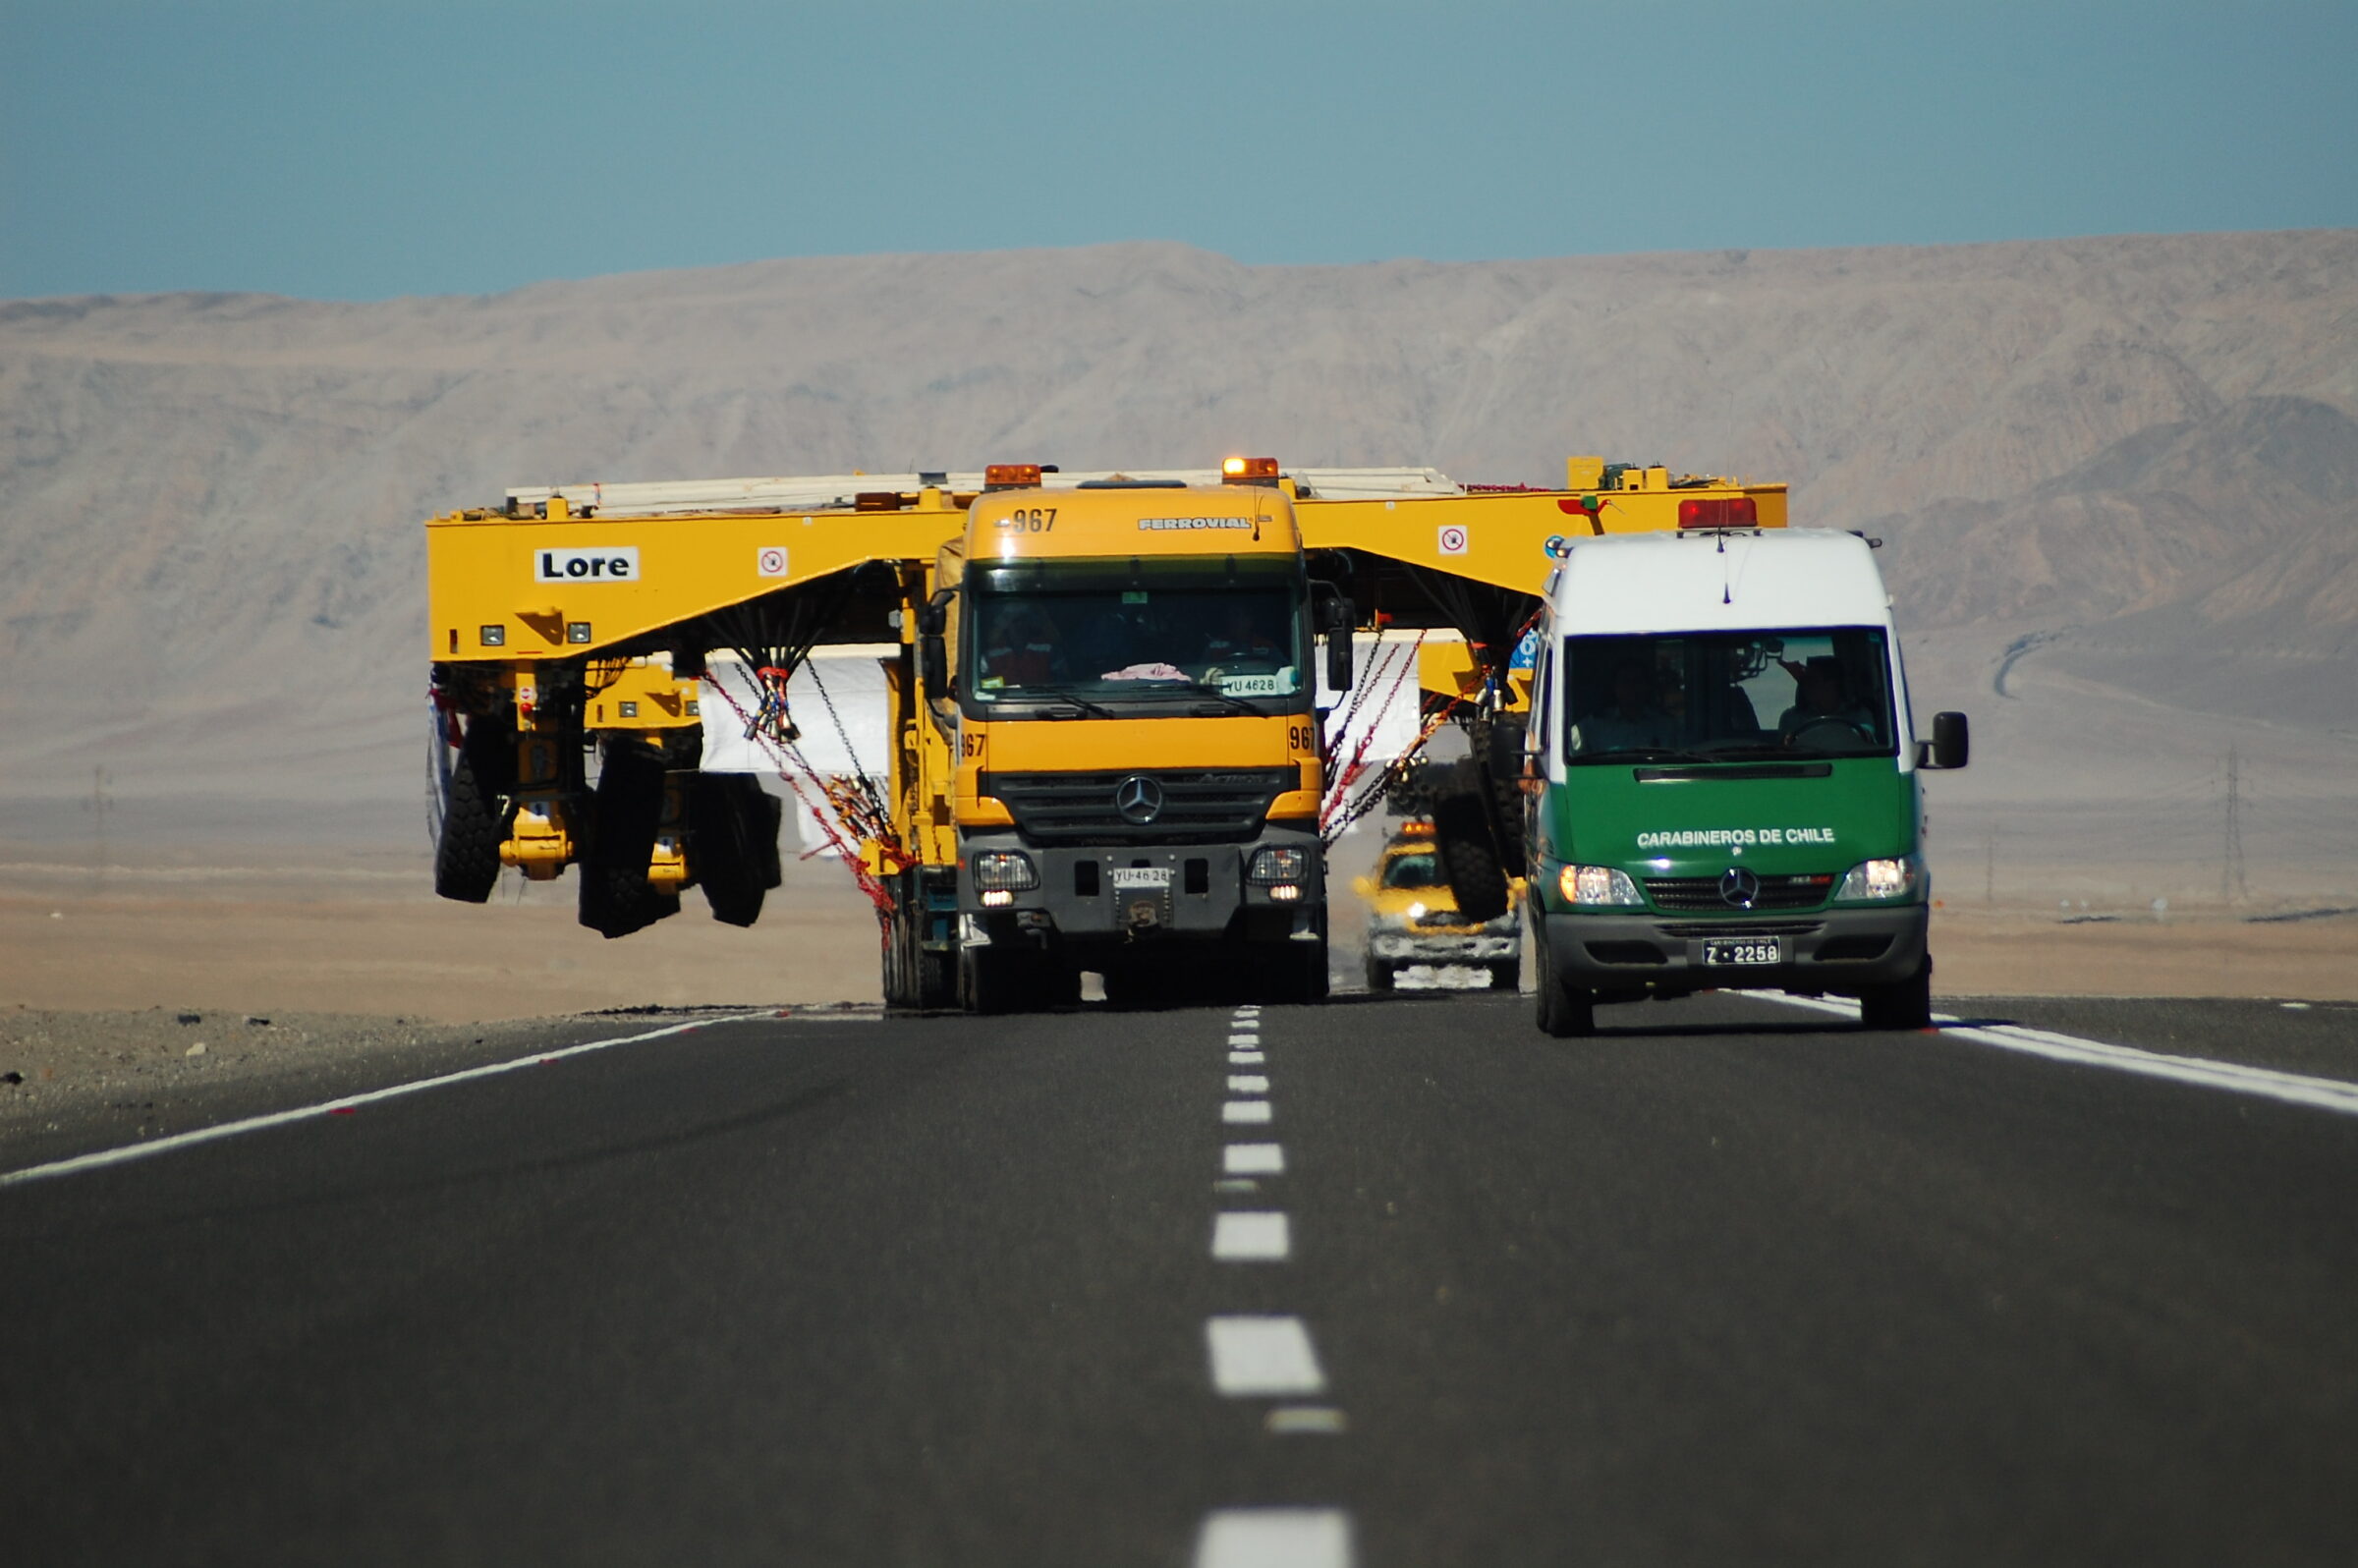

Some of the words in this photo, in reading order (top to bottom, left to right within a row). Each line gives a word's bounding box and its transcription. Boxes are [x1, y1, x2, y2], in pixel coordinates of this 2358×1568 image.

[1013, 508, 1057, 532] 967
[1138, 517, 1252, 531] FERROVIAL
[542, 552, 630, 578] Lore
[1245, 680, 1274, 691] 4628
[1637, 830, 1756, 849] CARABINEROS
[1759, 829, 1782, 844] DE
[1785, 828, 1835, 844] CHILE
[1734, 944, 1777, 962] 2258
